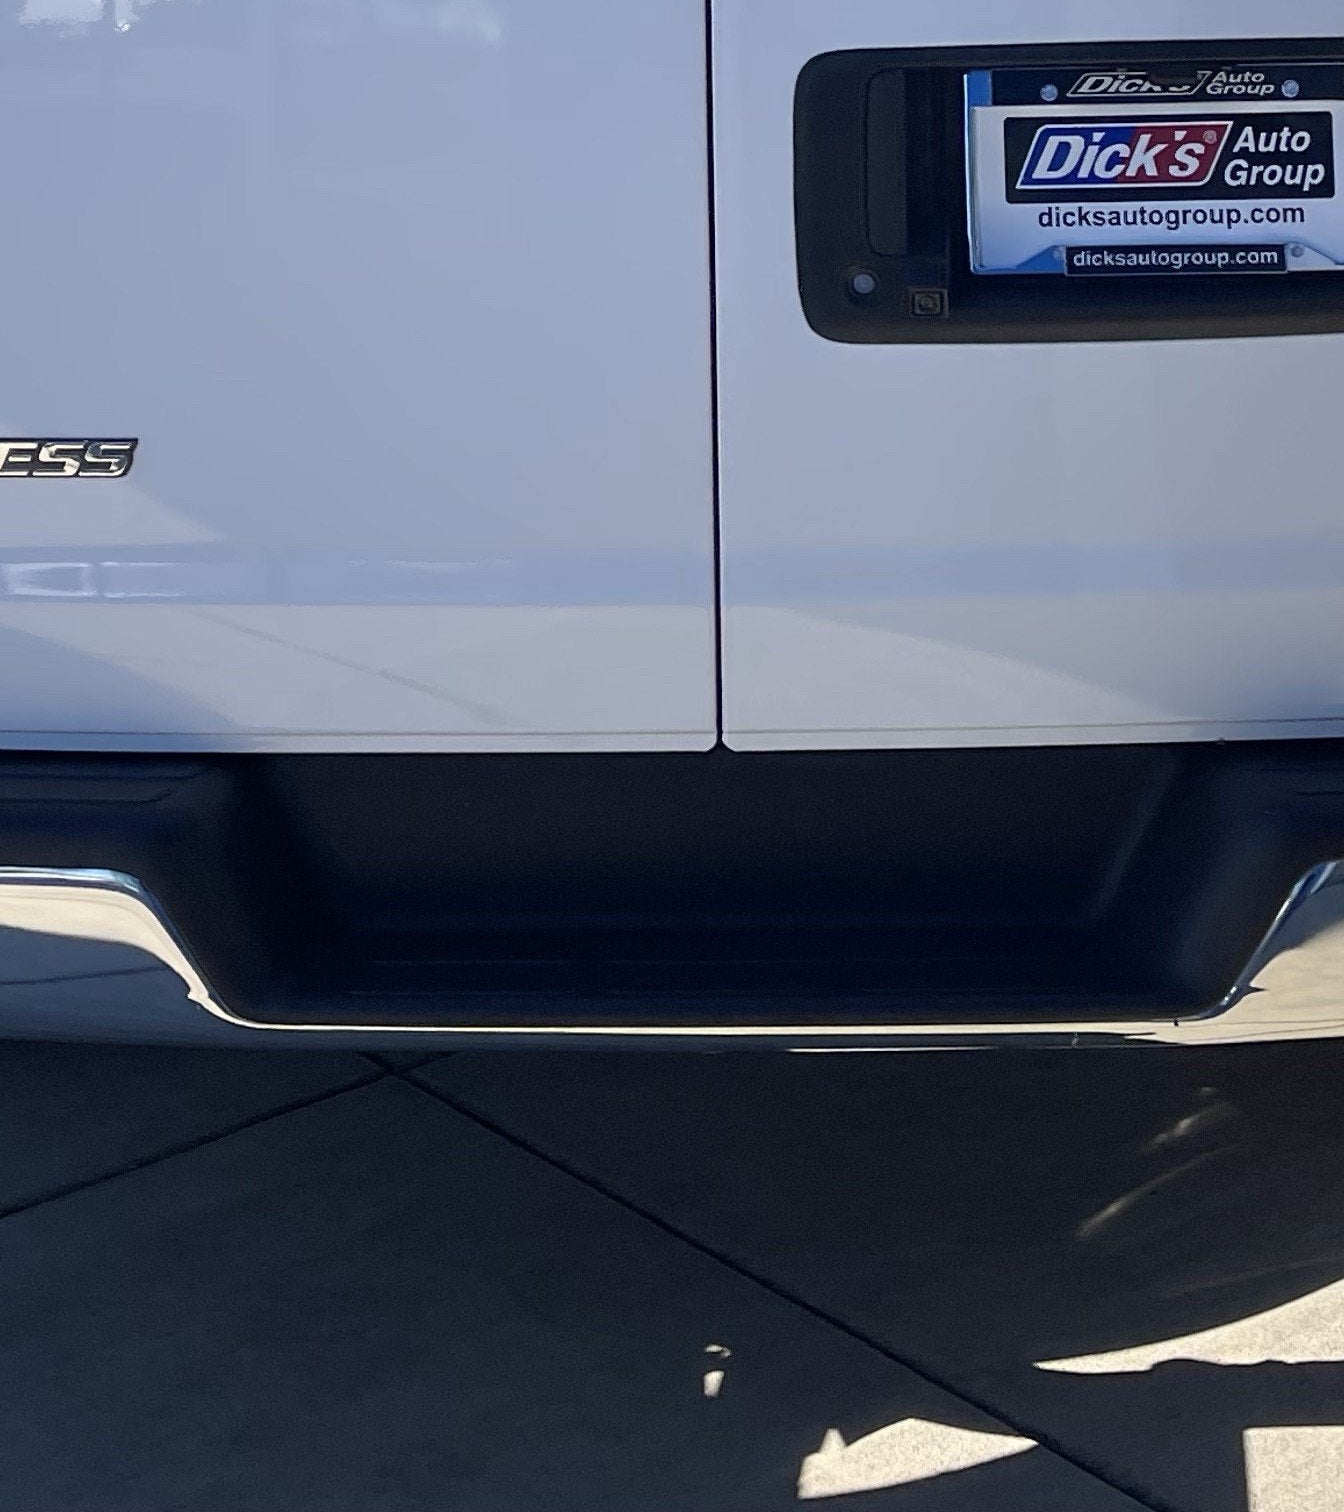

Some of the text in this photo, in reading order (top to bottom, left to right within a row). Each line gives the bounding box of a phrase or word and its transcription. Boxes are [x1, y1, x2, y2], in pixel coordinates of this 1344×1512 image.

[1212, 71, 1265, 83] Auto
[1205, 83, 1275, 96] Group
[1233, 126, 1311, 153] Auto
[1031, 130, 1206, 179] Dick's
[1224, 159, 1325, 191] Group
[1038, 206, 1306, 230] dicksautogroup.com
[1073, 249, 1278, 269] dicksautogroup.com
